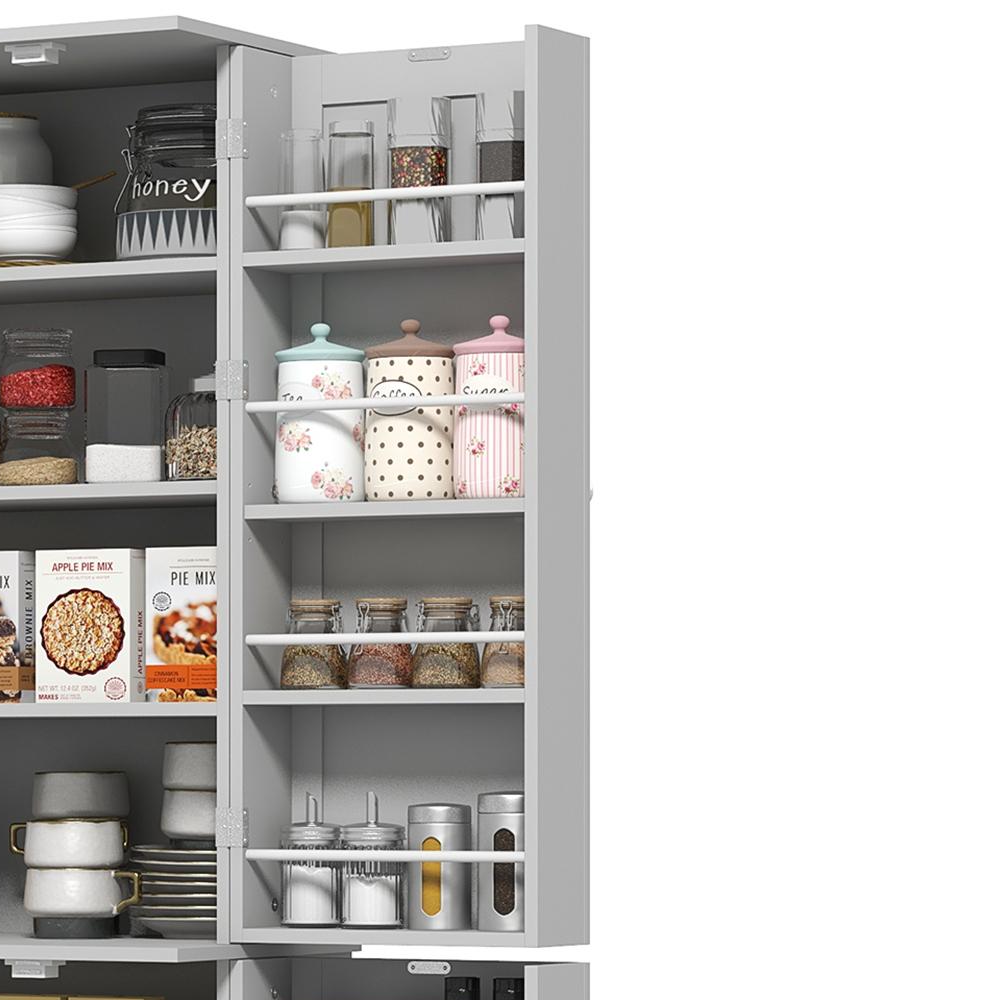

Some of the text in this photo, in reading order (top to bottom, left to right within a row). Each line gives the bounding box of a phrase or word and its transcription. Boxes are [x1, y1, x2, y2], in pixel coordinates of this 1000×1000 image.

[132, 175, 212, 202] honey
[51, 561, 113, 572] APPLE PIE MIX
[170, 571, 216, 586] PIE MIX
[25, 579, 33, 601] MIX
[25, 606, 33, 660] BROWNIE
